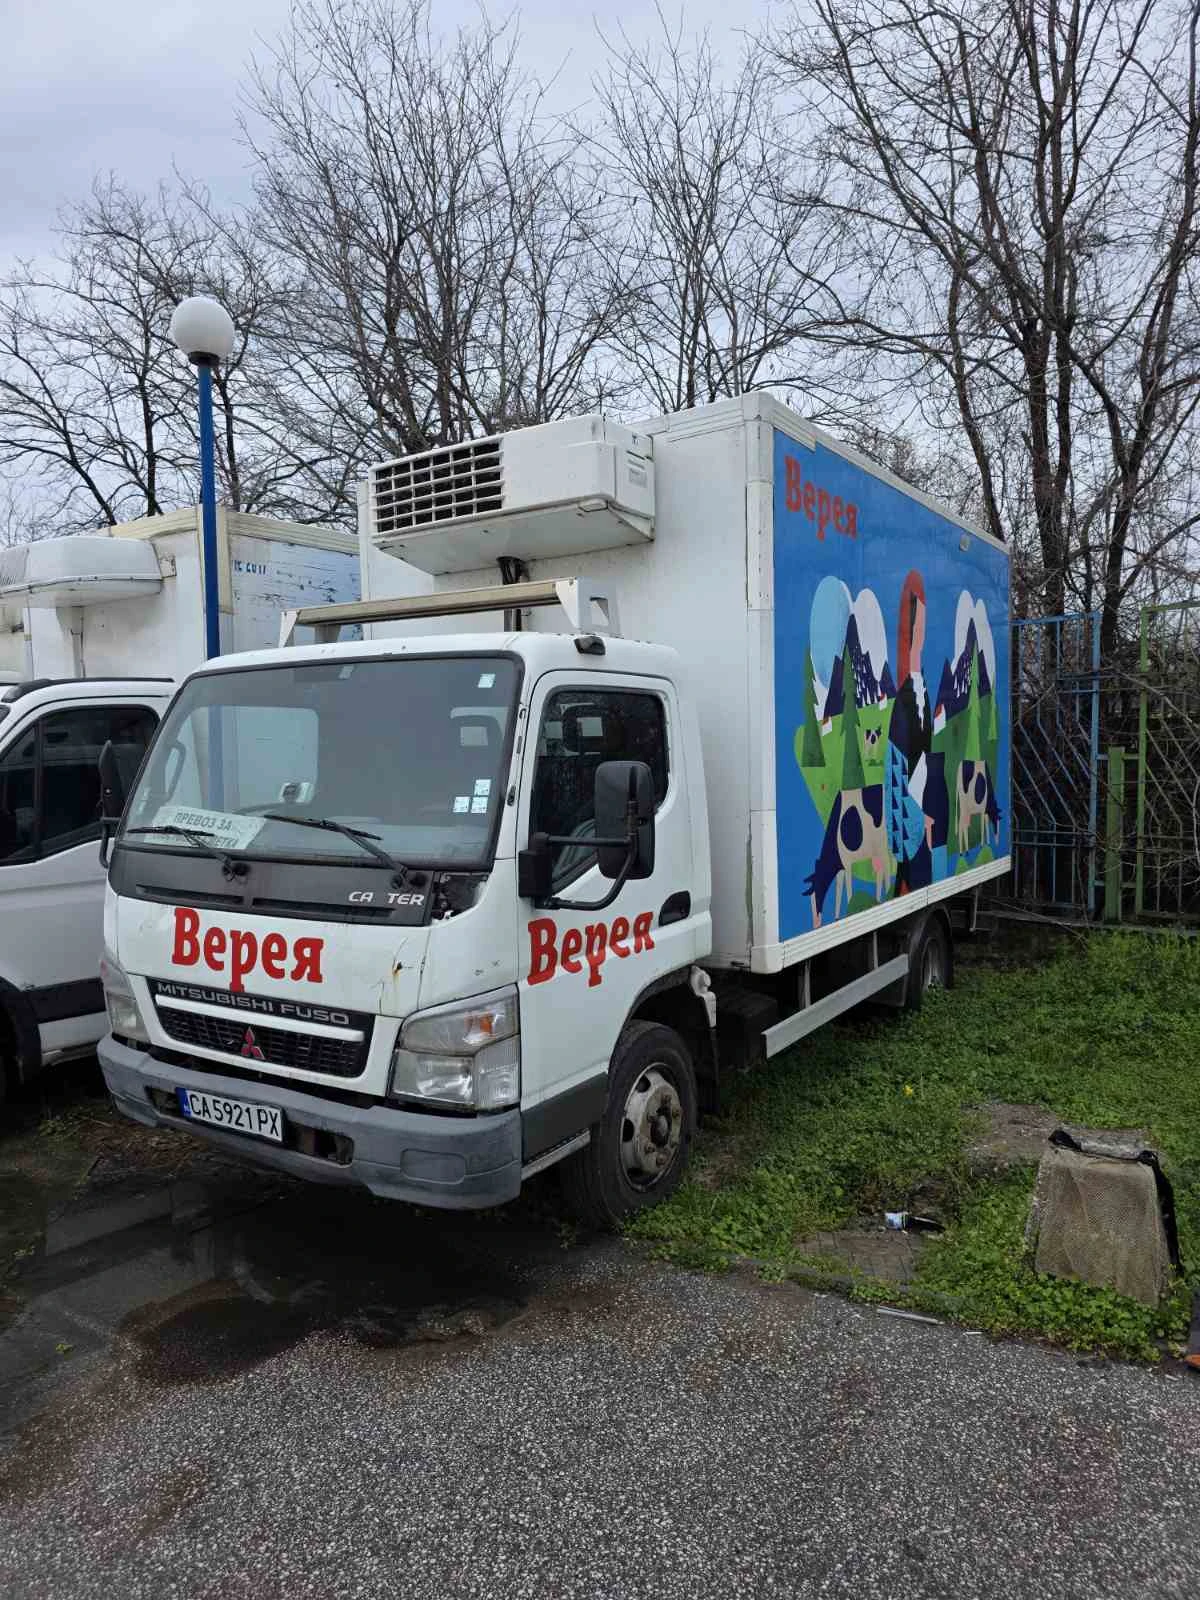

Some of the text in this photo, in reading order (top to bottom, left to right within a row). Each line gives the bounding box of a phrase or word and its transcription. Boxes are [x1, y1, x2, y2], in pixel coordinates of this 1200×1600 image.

[784, 455, 858, 541] Верея
[172, 907, 324, 992] Верея
[527, 911, 655, 987] Верея
[157, 982, 350, 1025] MITSUBISHI FUSO
